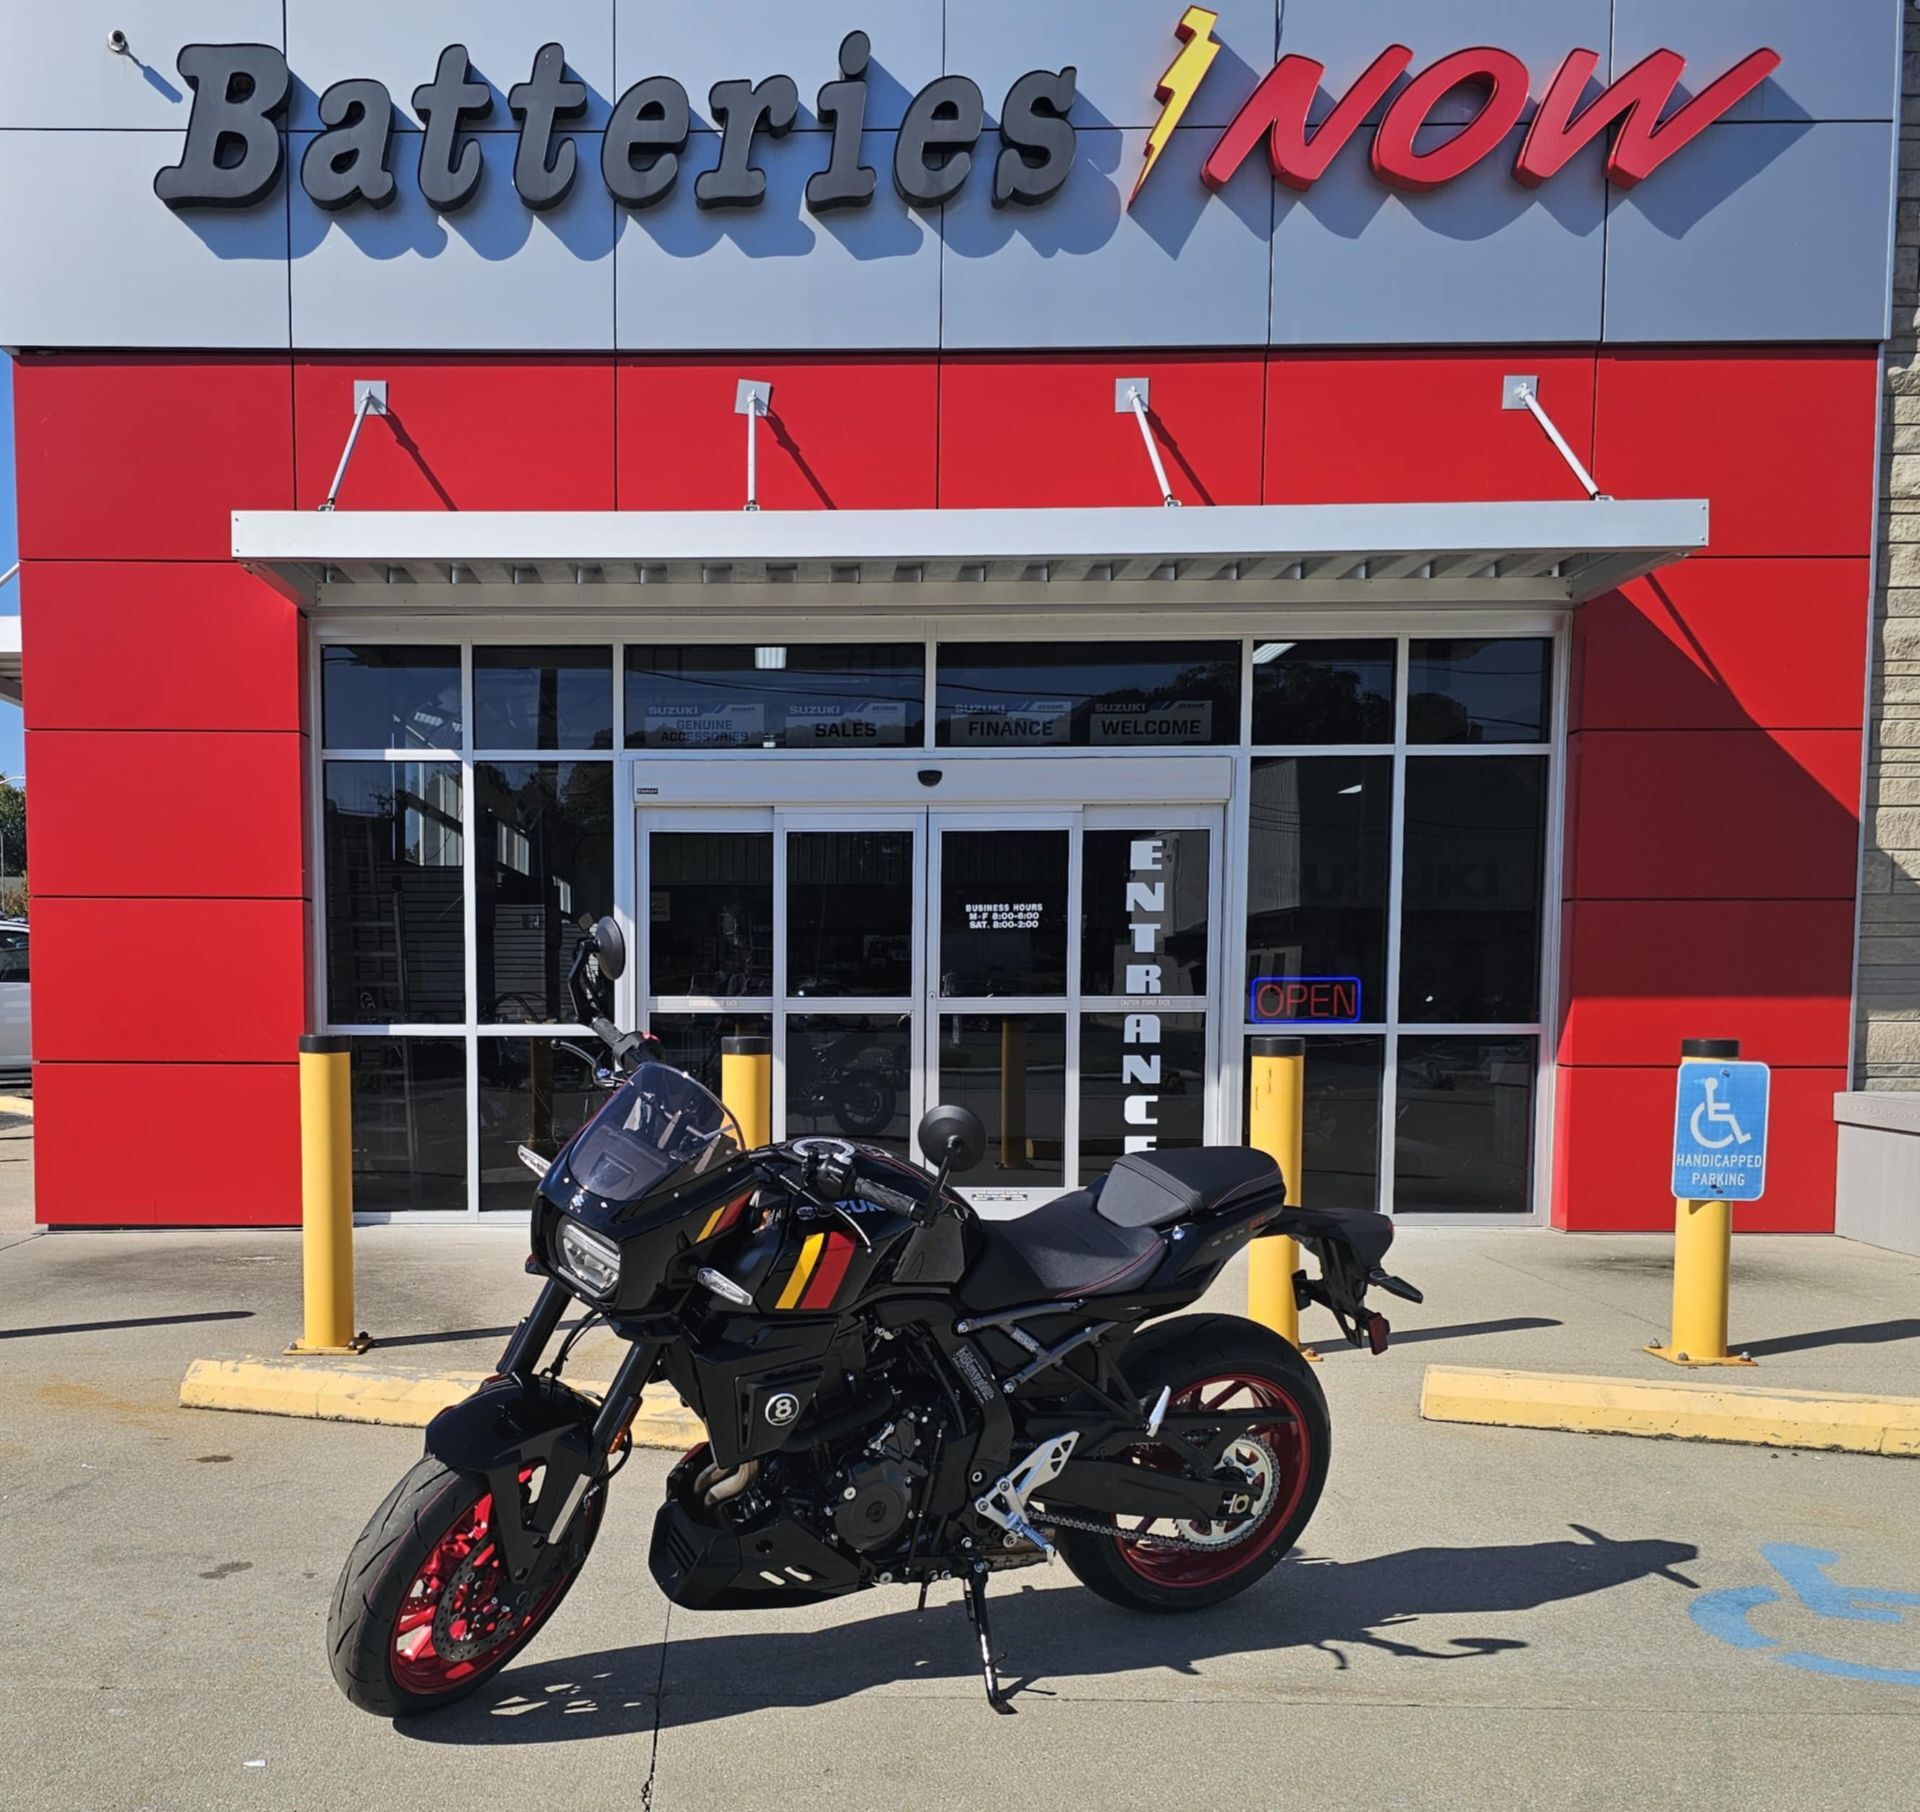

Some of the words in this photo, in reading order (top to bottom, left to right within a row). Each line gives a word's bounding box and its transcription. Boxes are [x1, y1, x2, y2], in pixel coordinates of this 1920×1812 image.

[153, 29, 1077, 210] Batteries
[1200, 43, 1782, 193] NOW
[648, 705, 699, 716] SUZUKI
[789, 704, 841, 715] SUZUKI
[954, 703, 1006, 714] SUZUKI
[1094, 703, 1146, 713] SUZUKI
[676, 719, 733, 730] GENUINE
[815, 722, 877, 738] SALES
[968, 720, 1054, 736] FINANCE
[1101, 719, 1201, 736] WELCOME
[660, 731, 749, 742] ACCESSORIES
[965, 903, 1010, 912] BUSINESS
[1013, 903, 1043, 912] HOURS
[969, 912, 989, 920] M-F
[992, 911, 1040, 920] 8:00-6:00
[969, 920, 990, 929] SAT.
[992, 920, 1039, 929] 8:00-2:00
[1122, 840, 1165, 1155] ENTRANCE
[1256, 983, 1356, 1017] OPEN
[1676, 1153, 1763, 1168] HANDICAPPED
[1691, 1172, 1746, 1187] PARKING
[774, 1398, 793, 1418] 8
